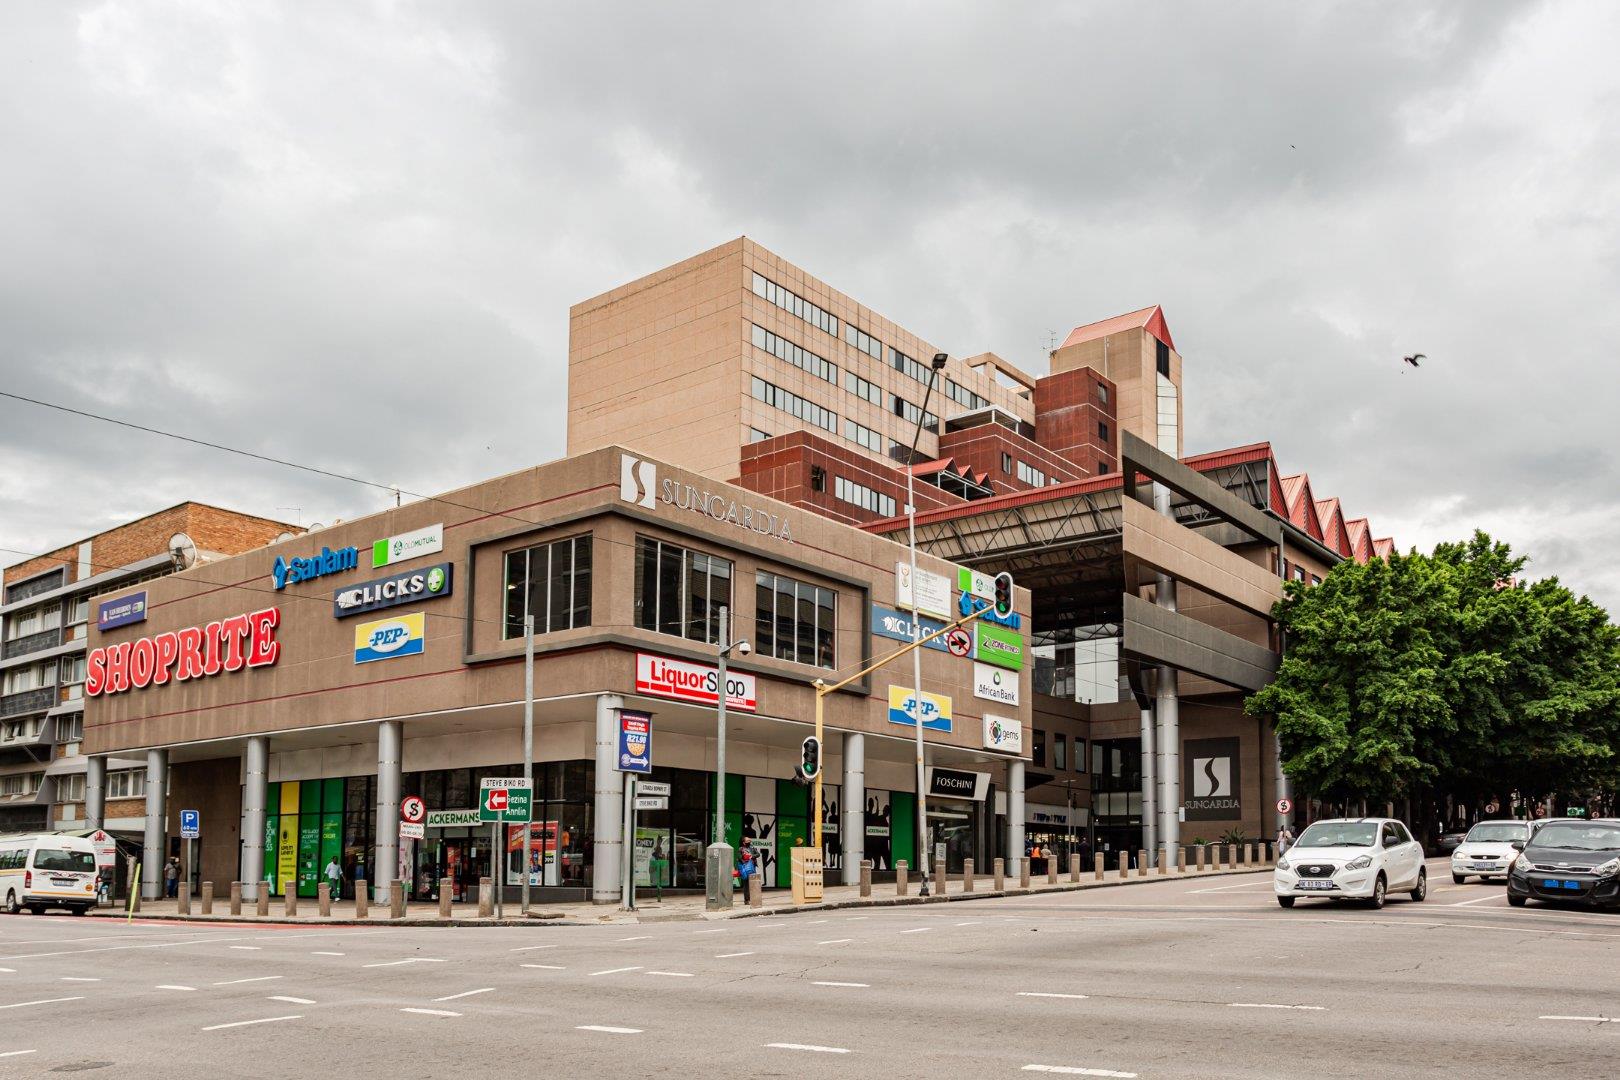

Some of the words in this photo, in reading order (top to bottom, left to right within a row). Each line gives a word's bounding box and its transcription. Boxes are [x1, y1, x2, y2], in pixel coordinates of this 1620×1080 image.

[352, 575, 424, 606] CLICKS
[86, 608, 280, 696] SHOPRITE
[650, 660, 745, 698] LiquorSop
[979, 684, 1000, 698] African
[1001, 690, 1015, 701] Bank
[1003, 730, 1018, 740] gems
[936, 777, 973, 789] FOSCHINI
[186, 814, 194, 822] P
[429, 812, 480, 825] ACKERMANS
